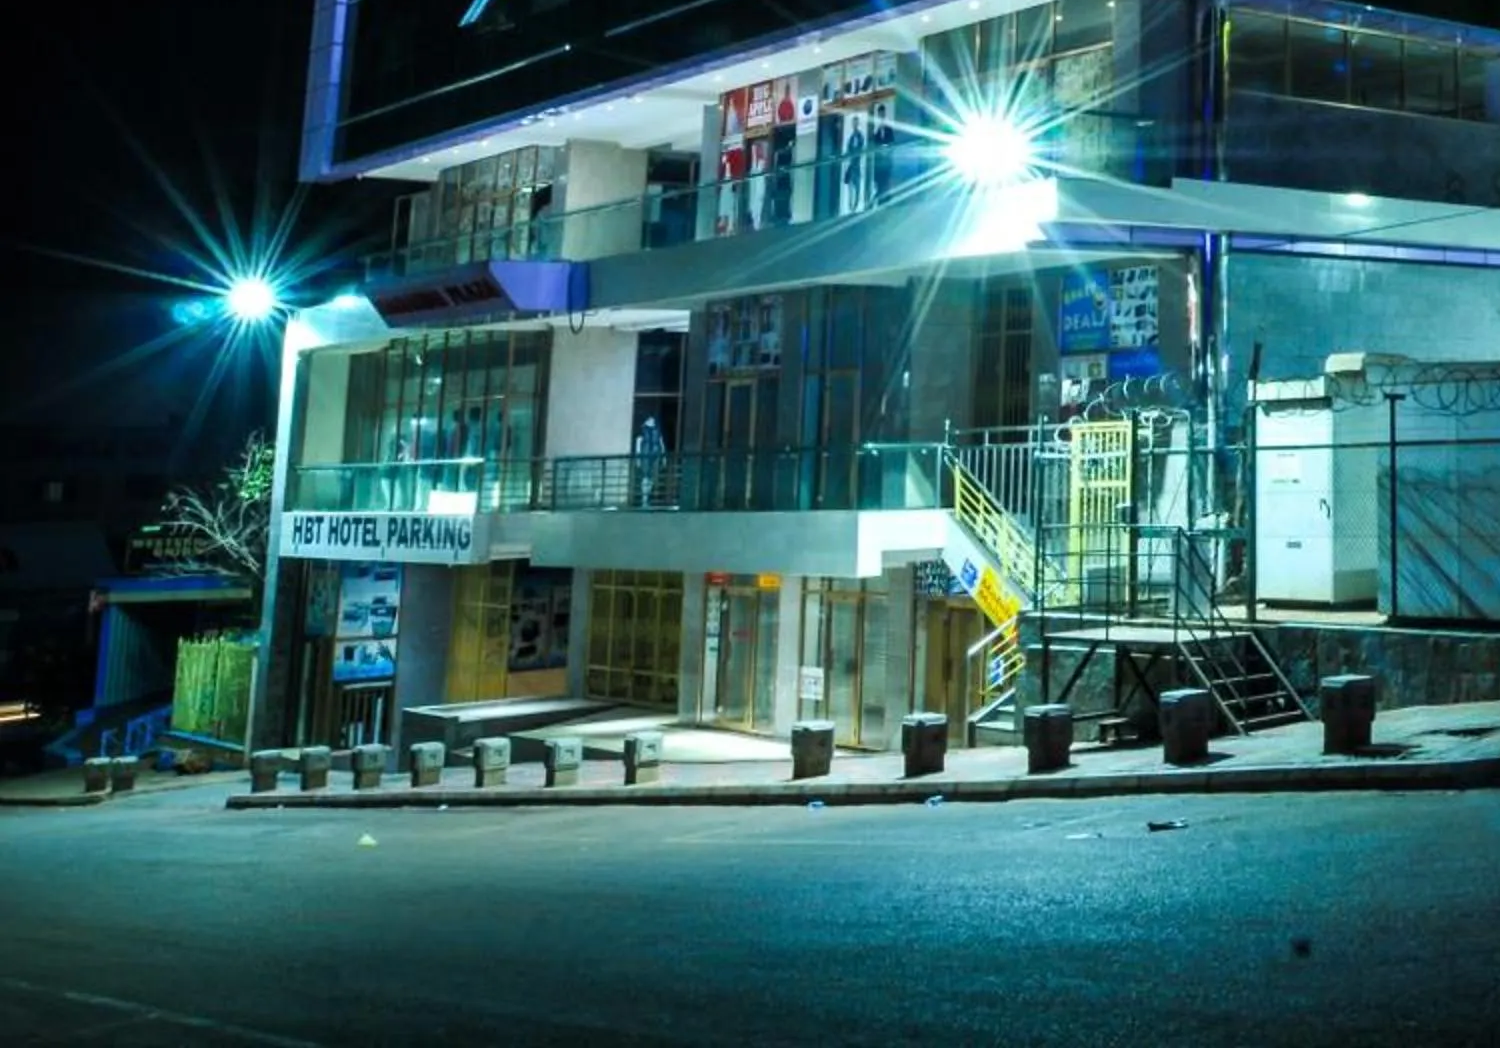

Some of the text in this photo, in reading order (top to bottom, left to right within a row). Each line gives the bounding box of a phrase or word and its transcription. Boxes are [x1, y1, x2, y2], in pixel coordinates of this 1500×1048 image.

[292, 516, 471, 550] HBT HOTEL PARKING
